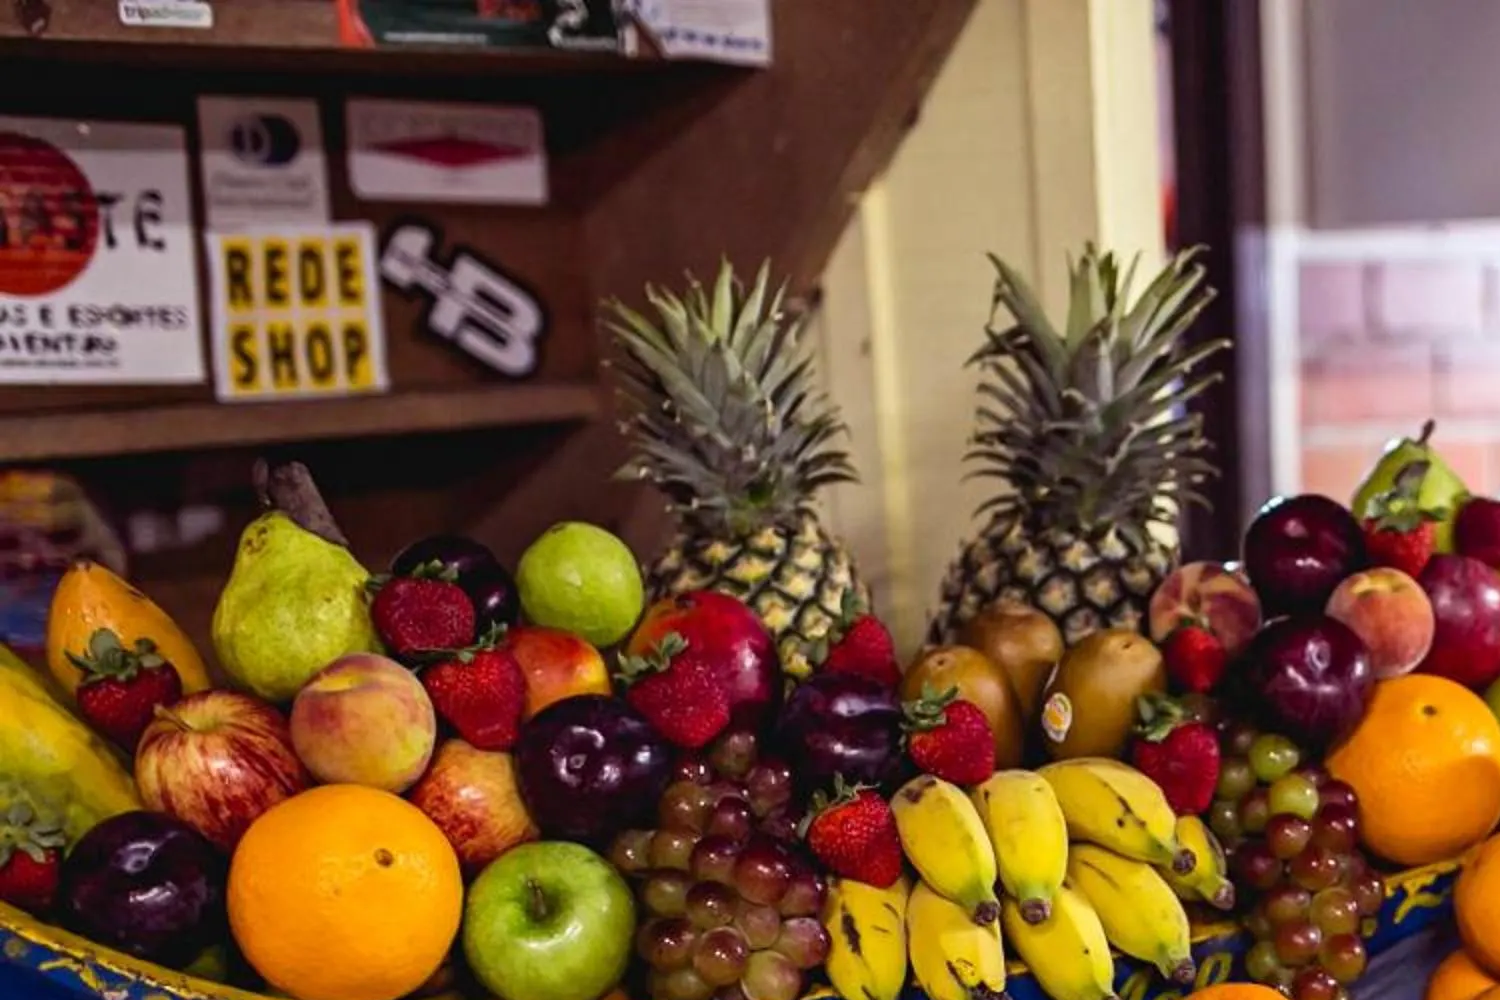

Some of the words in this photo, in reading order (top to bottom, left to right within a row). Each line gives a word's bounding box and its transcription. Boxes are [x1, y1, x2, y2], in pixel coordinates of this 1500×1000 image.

[123, 5, 207, 20] tripad
[225, 242, 363, 309] REDE
[38, 304, 52, 328] E
[231, 325, 369, 386] SHOP
